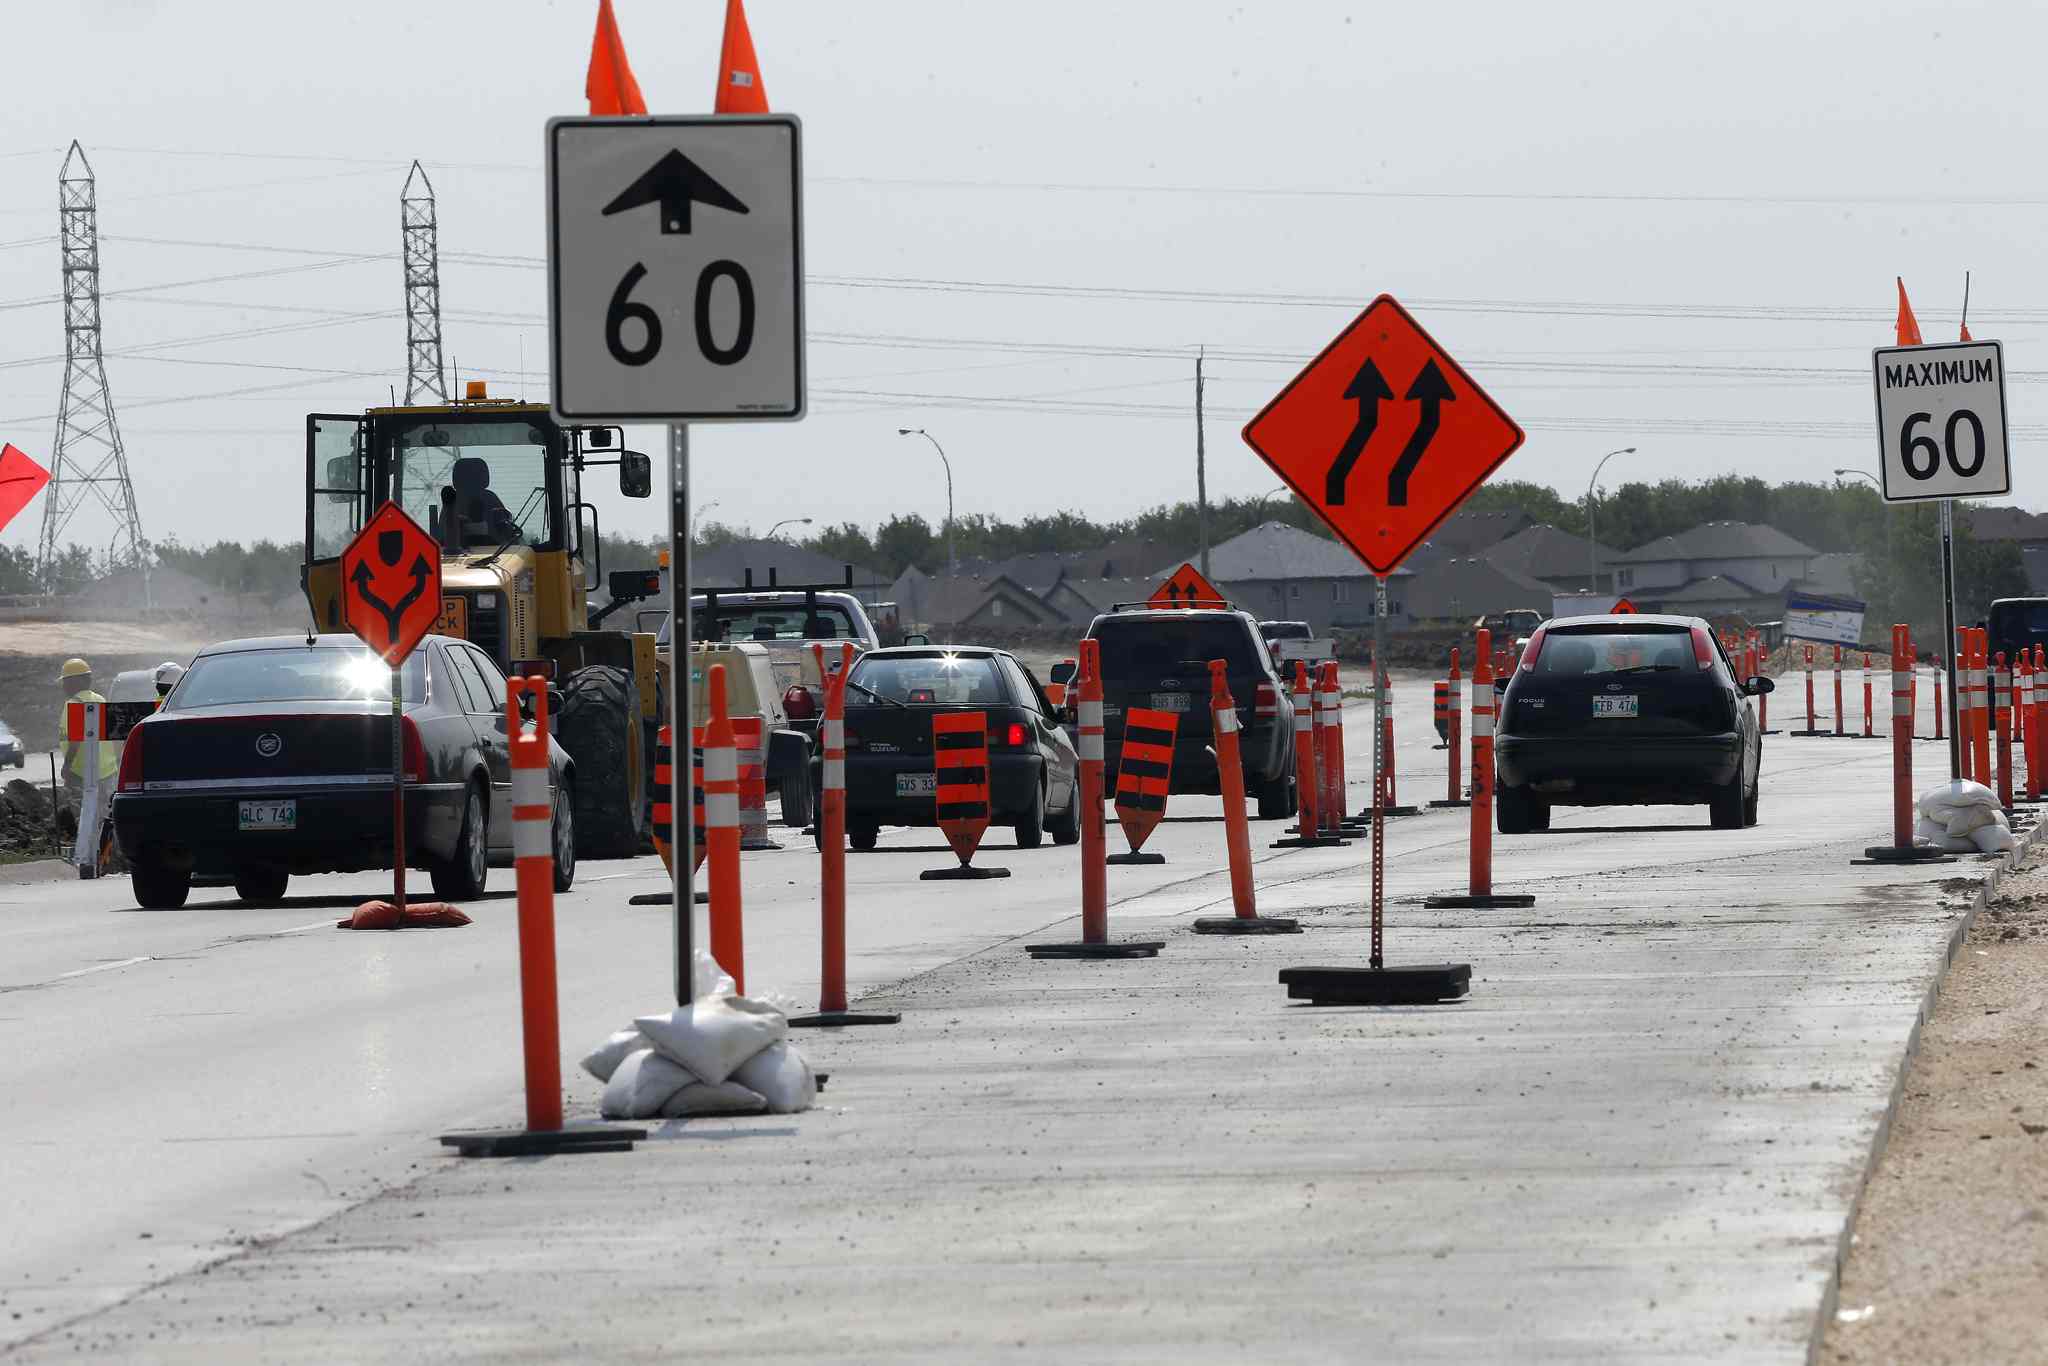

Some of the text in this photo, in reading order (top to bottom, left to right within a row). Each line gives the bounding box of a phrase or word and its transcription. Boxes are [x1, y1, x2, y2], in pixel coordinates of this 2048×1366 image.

[604, 259, 755, 367] 60
[1885, 358, 1993, 389] MAXIMUM
[1900, 409, 1986, 481] 60
[240, 807, 295, 822] GLC 743
